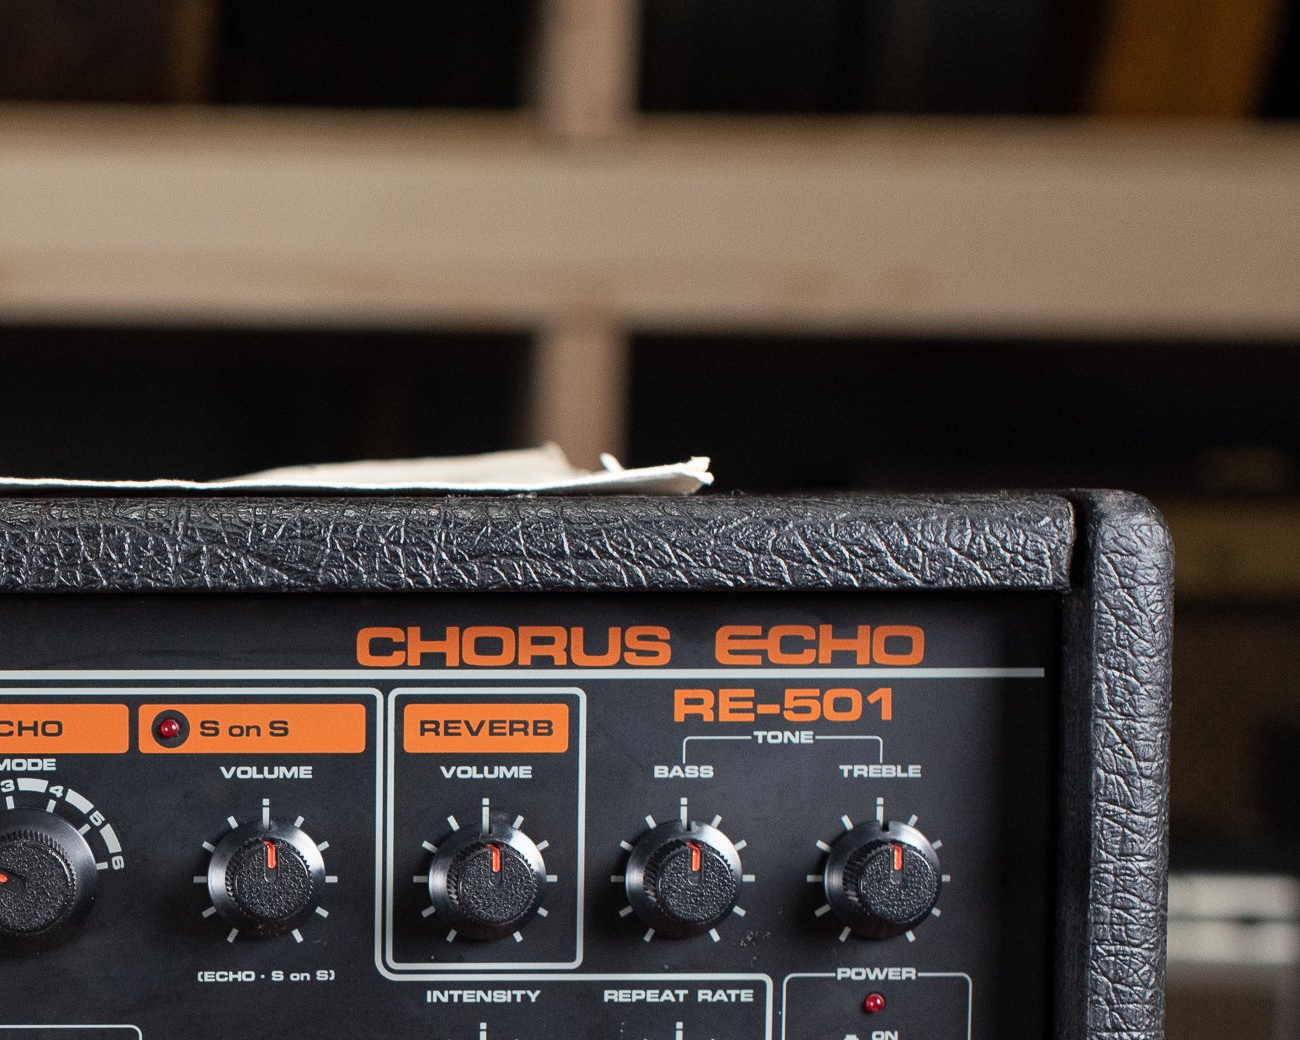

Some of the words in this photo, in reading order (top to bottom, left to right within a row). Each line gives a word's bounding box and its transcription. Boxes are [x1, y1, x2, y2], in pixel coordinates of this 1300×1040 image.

[357, 626, 671, 667] CHORUS
[715, 625, 925, 666] ECHO
[674, 688, 892, 722] RE-501
[199, 719, 220, 737] S
[228, 724, 262, 738] on
[268, 720, 289, 738] S
[419, 719, 554, 737] REVERB
[753, 731, 814, 744] TONE
[219, 765, 313, 779] VOLUME
[439, 765, 533, 779] VOLUME
[653, 765, 715, 779] BASS
[838, 764, 922, 778] TREBLE
[0, 778, 16, 794] 3
[49, 785, 64, 798] 4
[90, 810, 105, 826] 5
[112, 856, 124, 870] 6
[197, 970, 256, 983] (ECHO
[271, 970, 285, 982] S
[289, 972, 311, 982] on
[315, 969, 336, 981] S)
[837, 967, 916, 981] POWER
[426, 989, 542, 1003] INTENSITY
[603, 989, 689, 1003] REPEAT
[697, 989, 754, 1003] RATE
